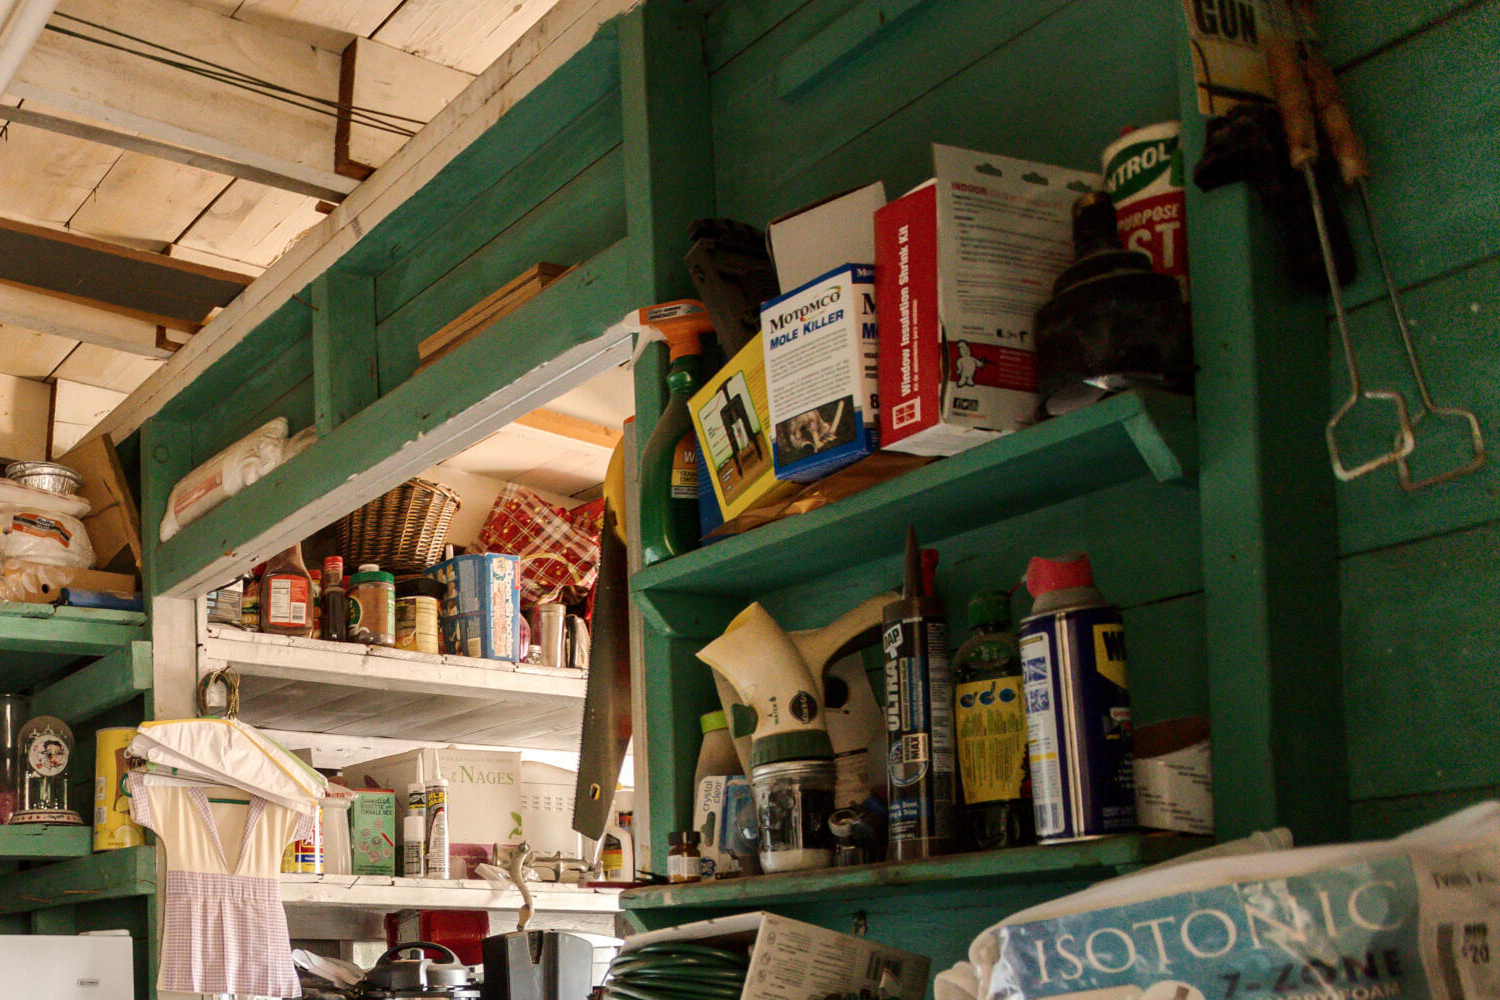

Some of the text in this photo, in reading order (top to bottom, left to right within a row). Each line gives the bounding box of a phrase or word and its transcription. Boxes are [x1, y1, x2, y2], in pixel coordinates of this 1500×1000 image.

[770, 291, 841, 334] MOTOMCO
[770, 329, 799, 350] MOLE
[803, 309, 844, 335] KILLER
[898, 225, 911, 397] Window Insulation Shrink Kit
[460, 765, 515, 785] NAGES
[714, 781, 722, 804] clear
[703, 781, 713, 812] crystal
[1033, 874, 1402, 985] ISOTONIC
